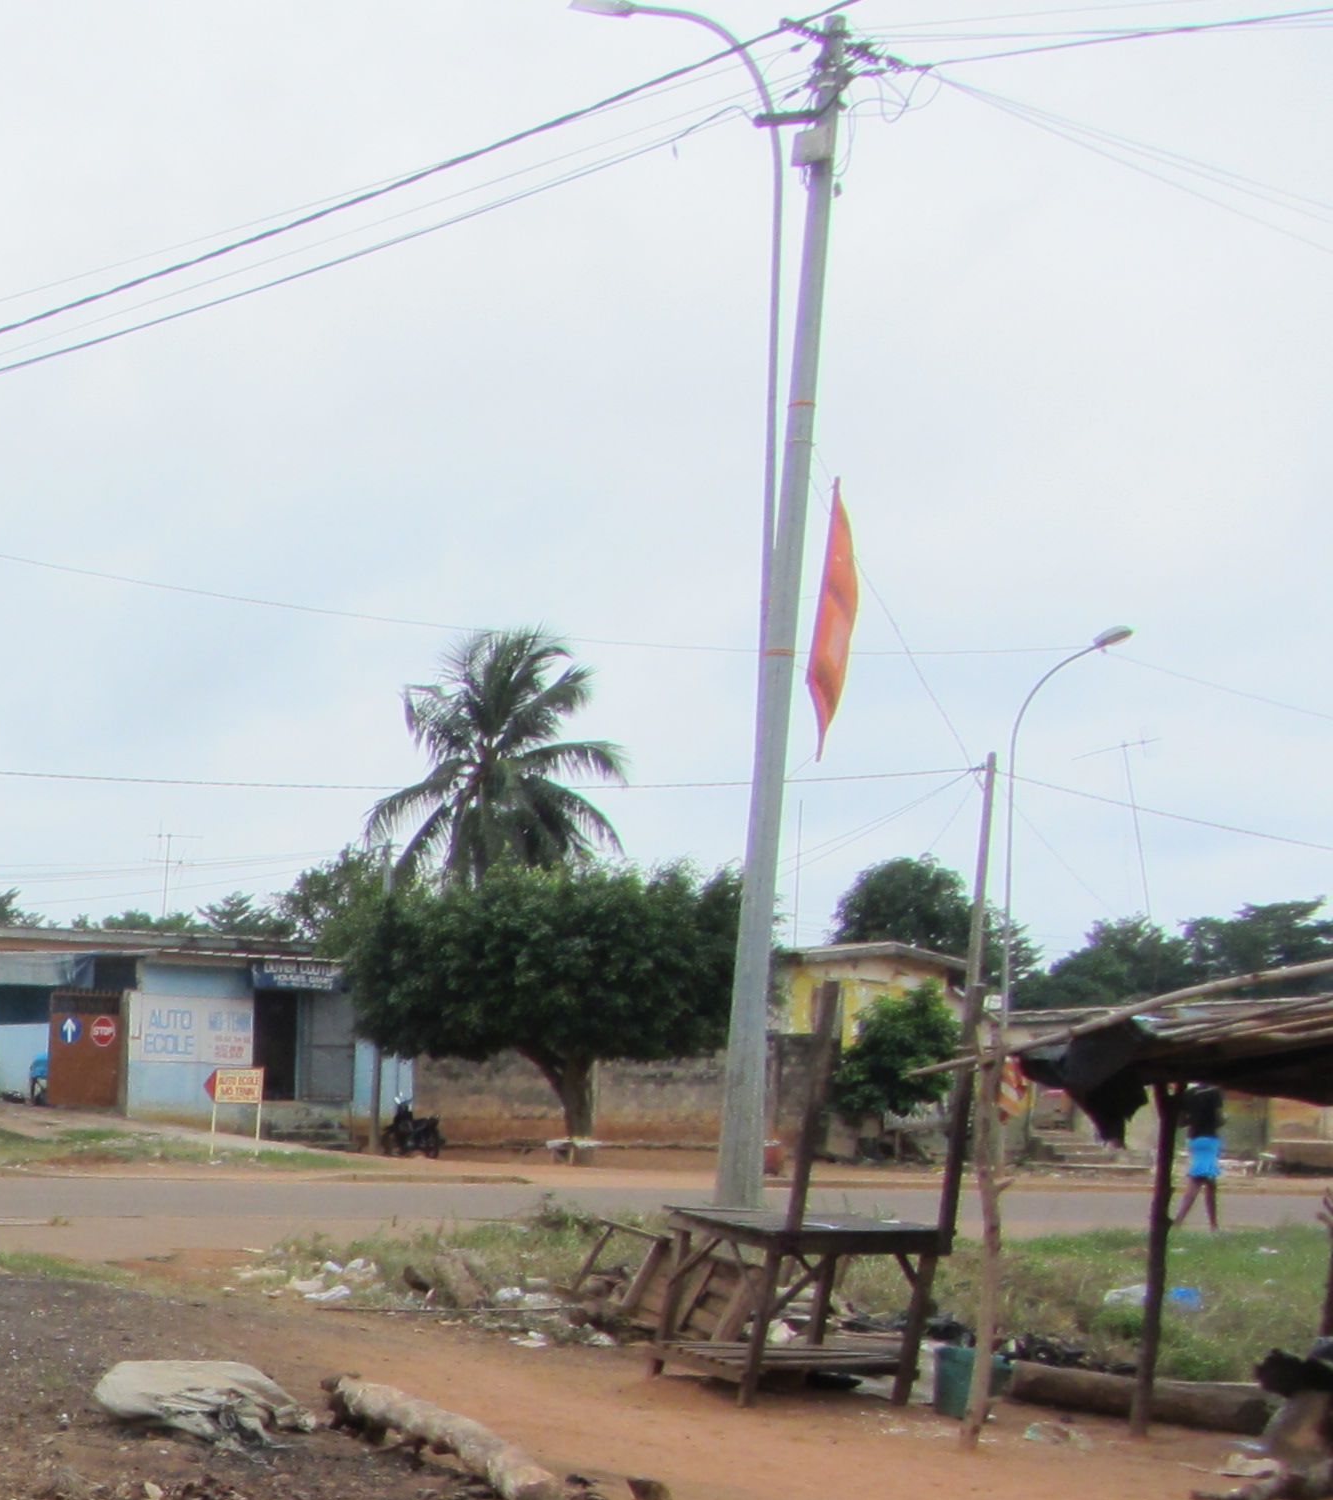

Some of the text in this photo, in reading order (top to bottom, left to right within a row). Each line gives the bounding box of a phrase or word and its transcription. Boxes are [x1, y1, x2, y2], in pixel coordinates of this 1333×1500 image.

[149, 1008, 192, 1030] AUTO
[93, 1025, 114, 1036] STOP
[144, 1033, 195, 1055] ECOLE
